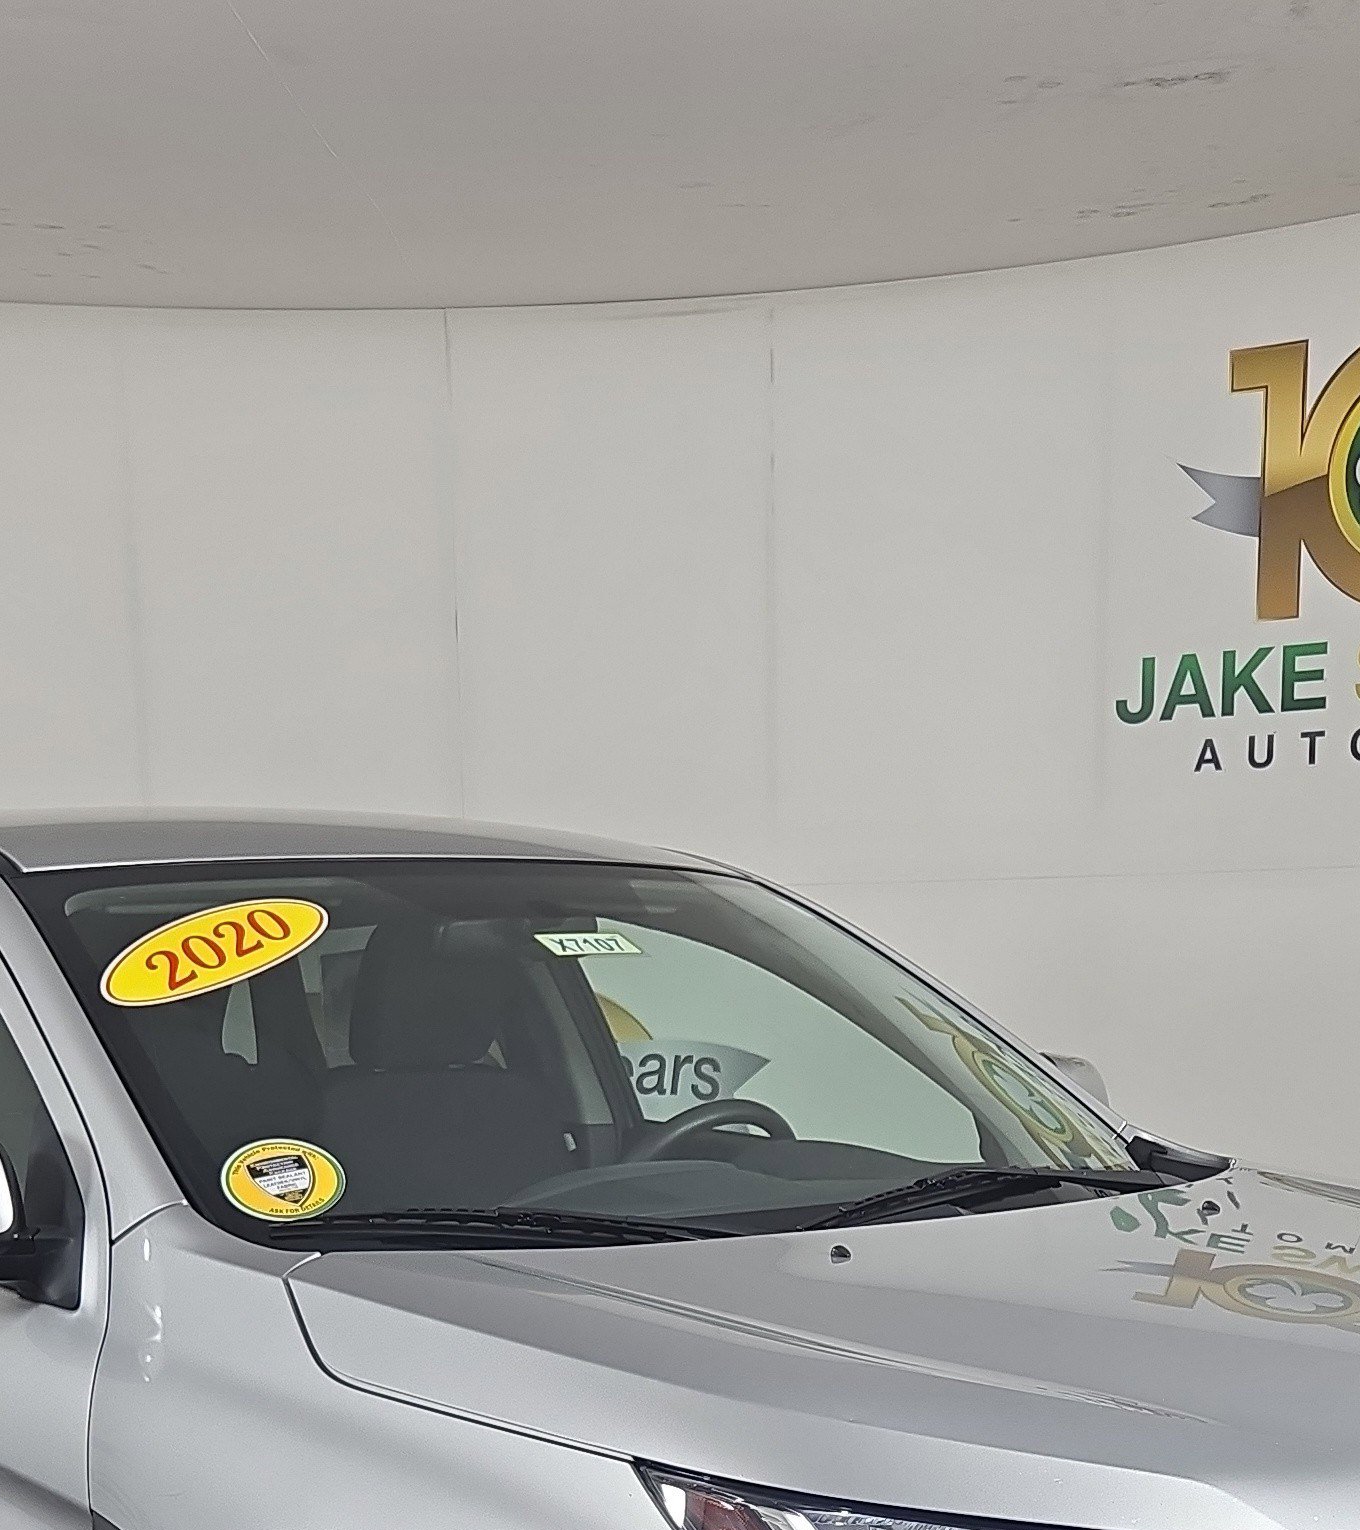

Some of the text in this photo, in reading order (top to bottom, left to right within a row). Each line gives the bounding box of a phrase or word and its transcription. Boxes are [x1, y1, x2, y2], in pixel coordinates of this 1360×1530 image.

[1115, 641, 1329, 725] JAKE
[145, 909, 291, 991] 2020
[548, 938, 626, 952] X7107
[620, 1053, 722, 1101] ars
